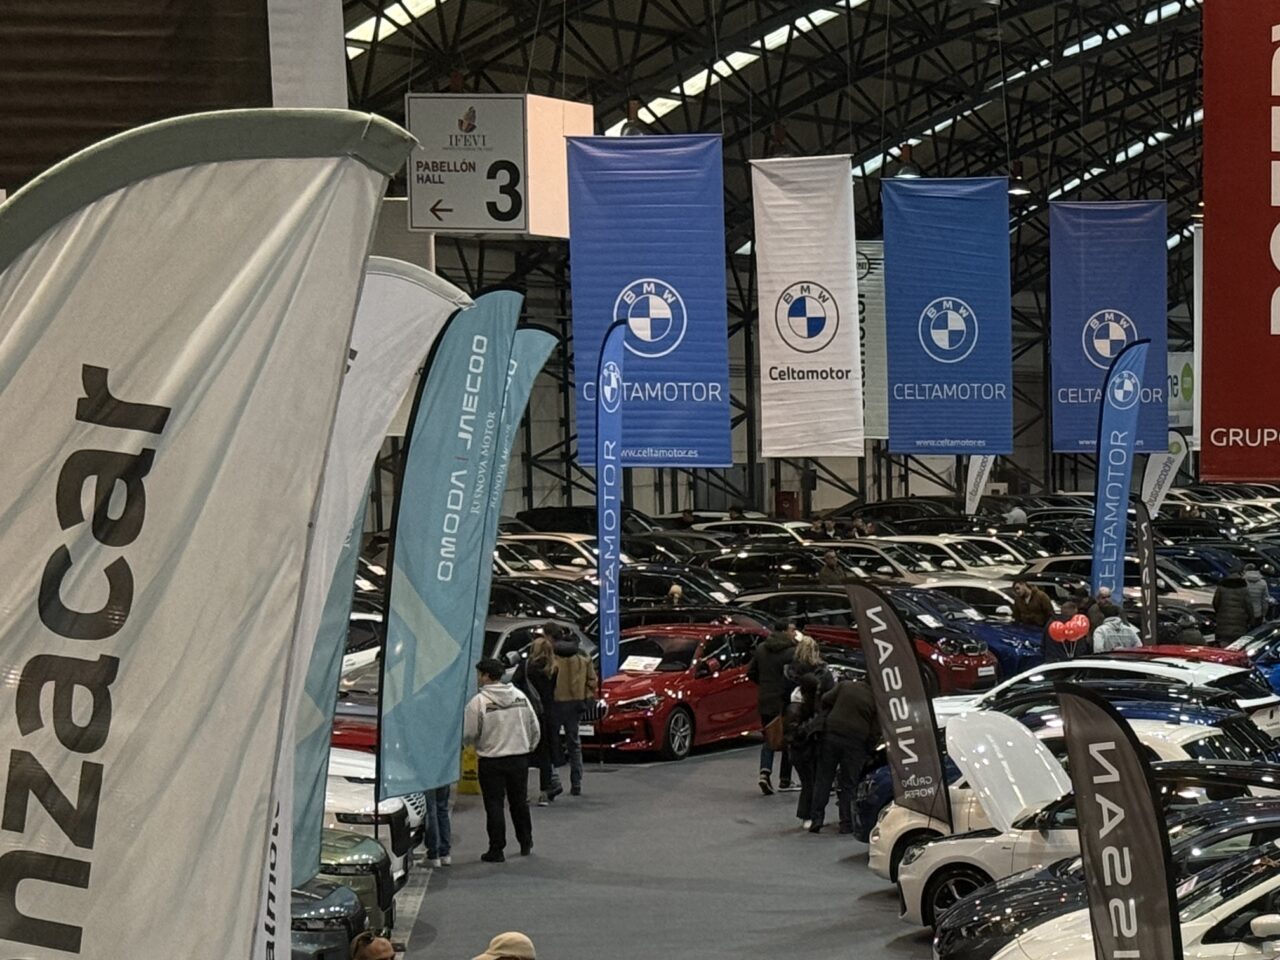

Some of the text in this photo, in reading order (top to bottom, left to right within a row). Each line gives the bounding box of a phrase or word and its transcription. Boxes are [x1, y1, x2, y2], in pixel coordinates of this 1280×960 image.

[449, 134, 486, 147] IFEVI
[416, 158, 476, 172] PABELLÓN
[416, 174, 445, 184] HALL
[485, 159, 522, 222] 3
[623, 283, 676, 305] BMW
[783, 285, 829, 305] BMW
[926, 300, 969, 319] BMW
[1090, 312, 1130, 329] BMW
[769, 366, 852, 380] Celtamotor
[583, 382, 722, 402] CTAMOTOR
[893, 383, 1007, 400] CELTAMOTOR
[1058, 388, 1163, 403] CELTAOR
[437, 334, 488, 582] OMODA JAECOO
[620, 447, 699, 458] ww.celtamotor.es
[605, 440, 617, 657] CELTAMOTOR
